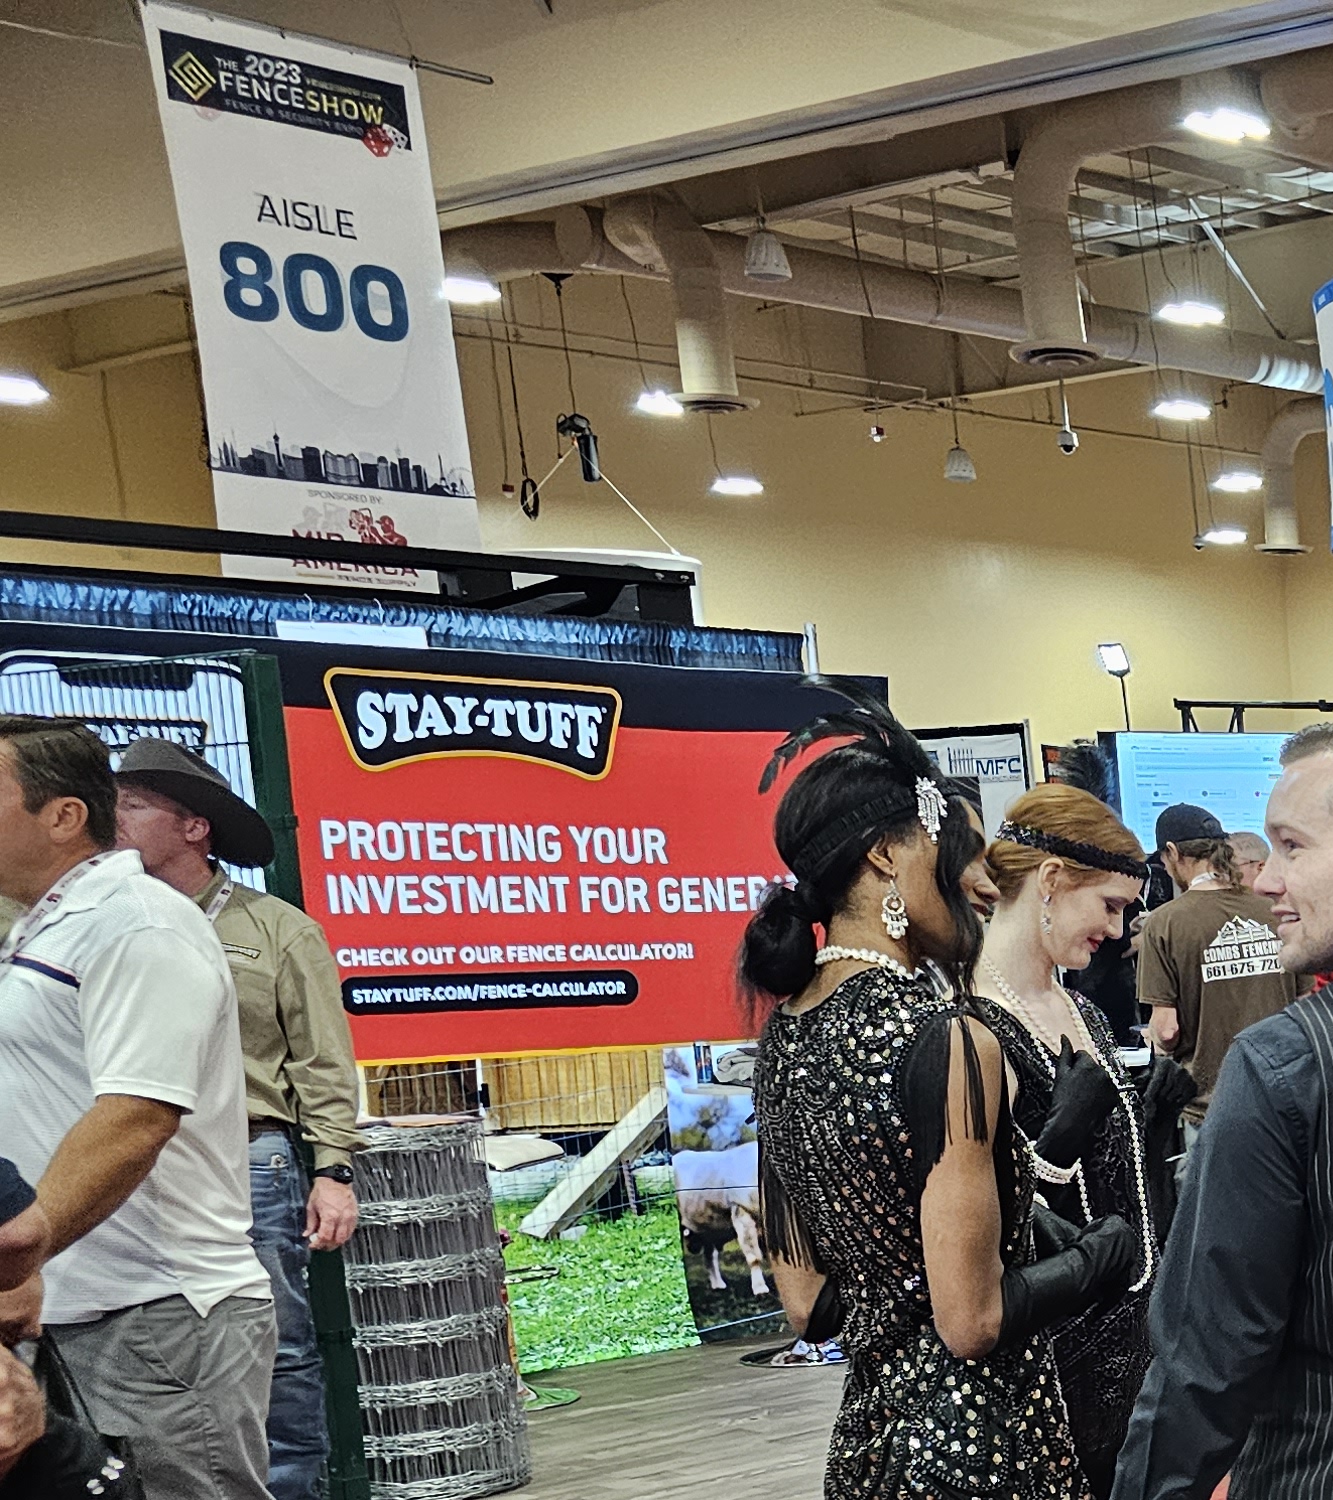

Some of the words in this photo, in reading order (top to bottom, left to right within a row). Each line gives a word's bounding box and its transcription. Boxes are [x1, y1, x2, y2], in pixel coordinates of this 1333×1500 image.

[213, 56, 238, 71] THE
[245, 54, 302, 83] 2023
[218, 71, 384, 125] FENCESHOW
[224, 99, 263, 115] FENCE
[256, 194, 358, 240] AISLE
[219, 241, 410, 343] 800
[306, 488, 366, 503] SPONSORED
[356, 690, 606, 759] STAY-TUFF
[975, 757, 1021, 776] MFC
[319, 819, 562, 863] PROTECTING
[568, 824, 668, 866] YOUR
[325, 873, 570, 915] INVESTMENT
[579, 876, 651, 914] FOR
[336, 945, 409, 968] CHECK
[411, 946, 456, 966] OUT
[459, 945, 504, 965] OUR
[506, 944, 567, 964] FENCE
[569, 942, 694, 964] CALCULATOR!
[1203, 945, 1241, 963] COMBS
[1241, 940, 1284, 958] FENCIN
[352, 980, 627, 1005] STAYTUFF.COM/FENCE-CALCULATOR
